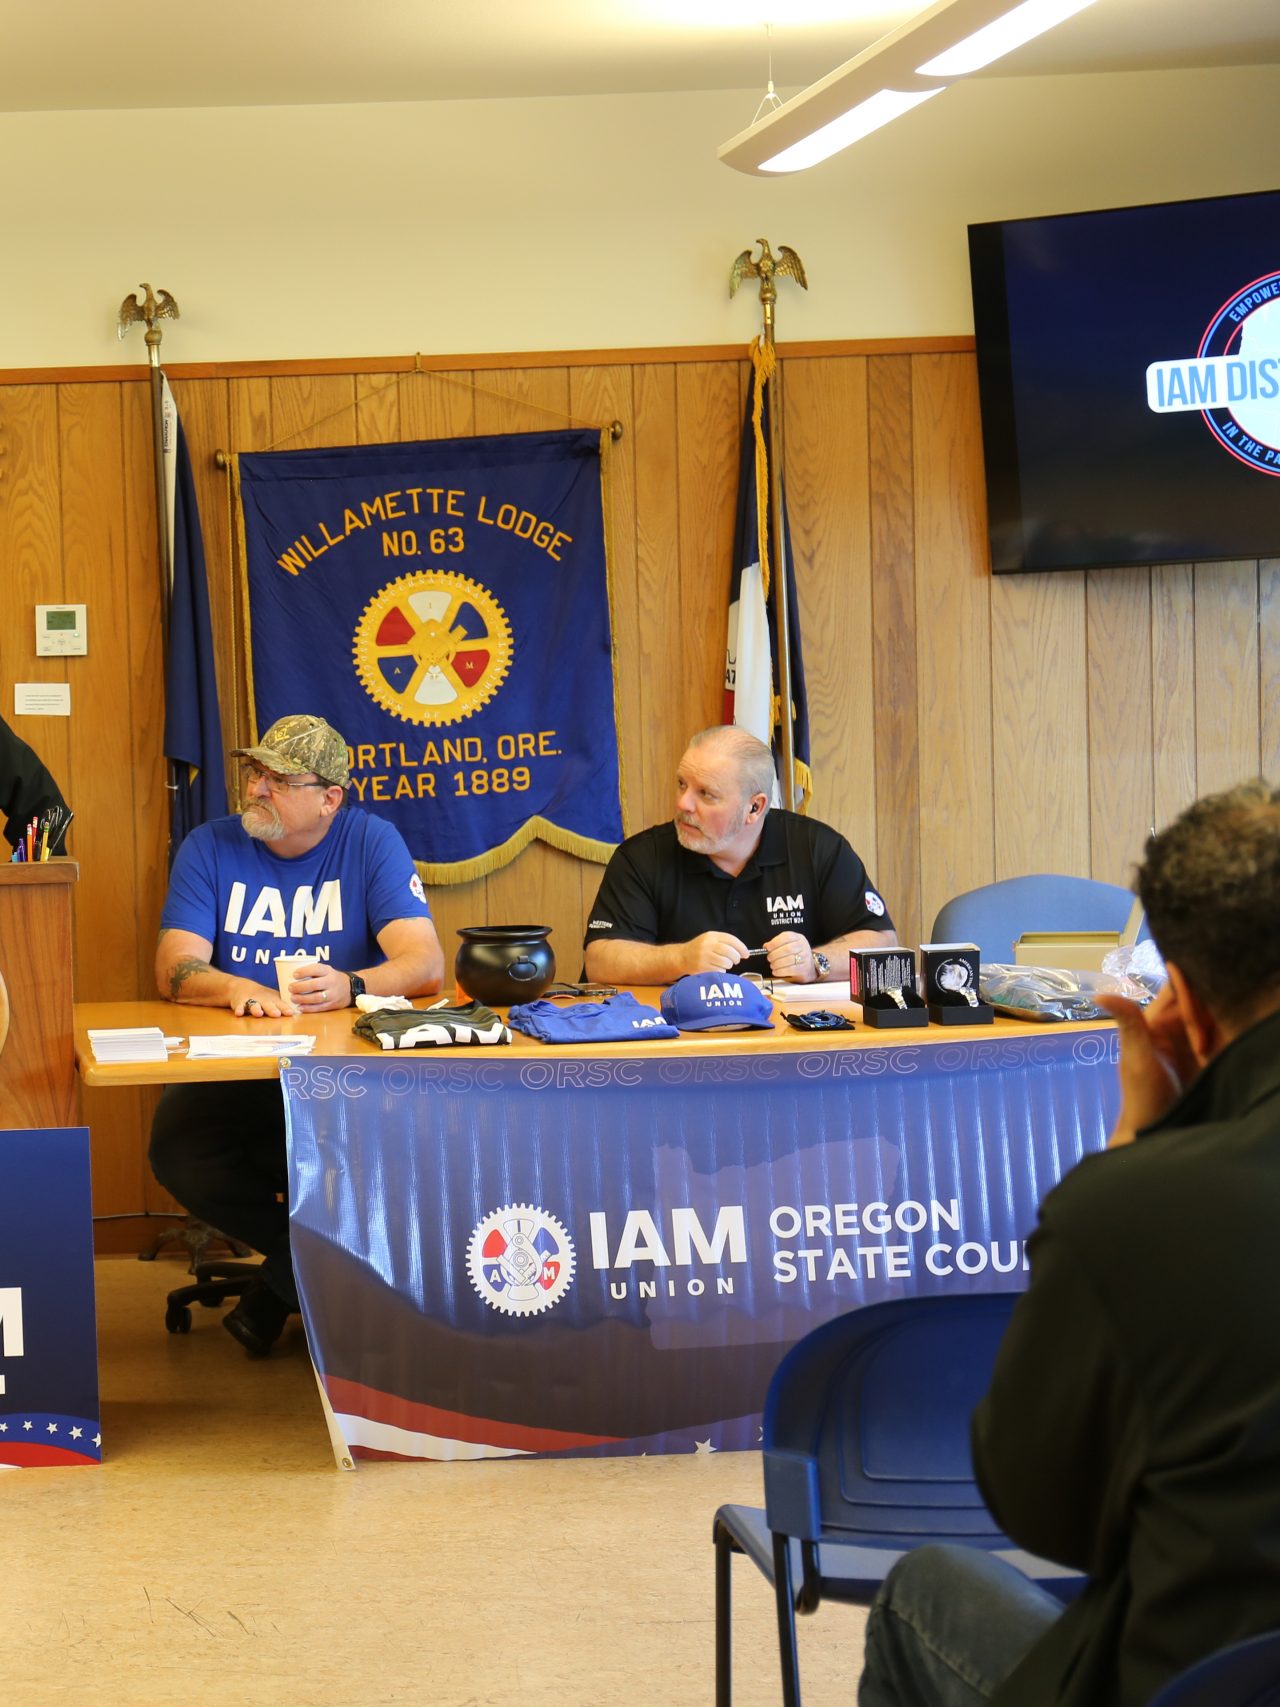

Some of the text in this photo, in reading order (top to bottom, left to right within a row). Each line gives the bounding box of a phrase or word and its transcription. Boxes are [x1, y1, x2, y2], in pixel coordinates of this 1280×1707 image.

[1229, 282, 1280, 322] EMPOWE
[1156, 358, 1280, 407] IAM DIS
[1222, 421, 1239, 438] IN
[1237, 435, 1264, 458] THE
[276, 488, 573, 577] WILLAMETTE LODGE
[382, 527, 465, 557] NO. 63
[497, 730, 562, 759] ORE.
[350, 766, 532, 802] YEAR 1889
[223, 878, 344, 938] IAM
[766, 894, 804, 913] IAM
[771, 917, 793, 926] DISTRICT
[773, 911, 802, 919] UNION
[699, 982, 744, 1000] IAM
[382, 1062, 505, 1096] ORSC
[520, 1060, 644, 1090] ORSC
[659, 1054, 783, 1084] ORSC
[796, 1047, 921, 1078] ORSC
[934, 1037, 1058, 1072] ORSC
[769, 1199, 961, 1239] OREGON
[589, 1206, 747, 1270] IAM
[490, 1266, 556, 1283] A M
[773, 1245, 912, 1283] STATE
[610, 1277, 734, 1300] UNION
